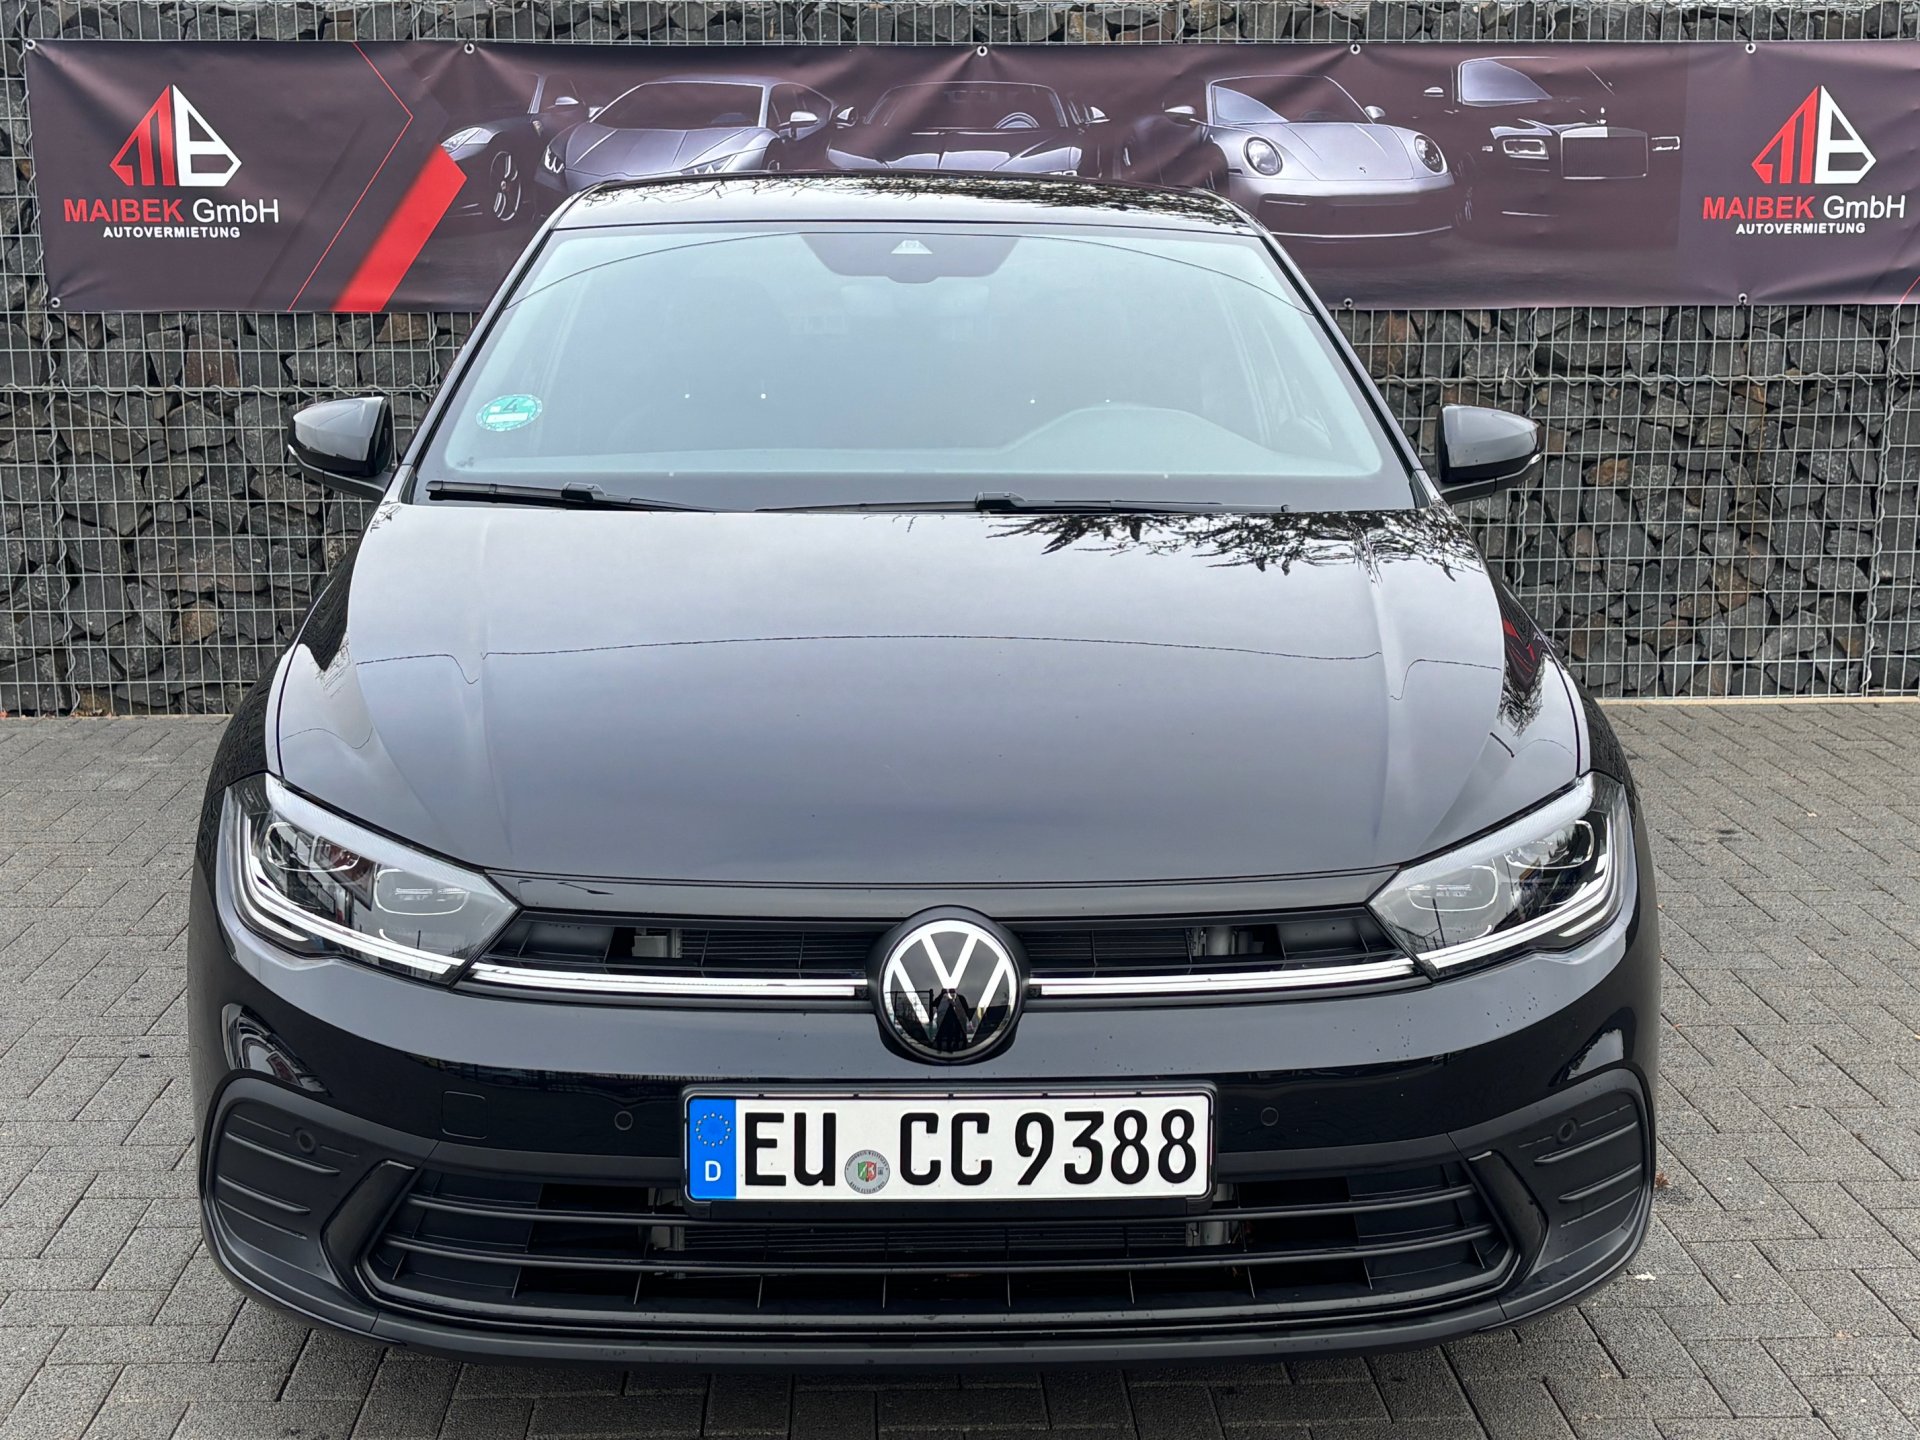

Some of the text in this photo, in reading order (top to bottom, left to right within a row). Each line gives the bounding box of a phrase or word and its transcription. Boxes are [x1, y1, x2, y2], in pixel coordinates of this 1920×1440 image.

[63, 197, 279, 224] MAIBEK GmbH
[1702, 194, 1906, 221] MAIBEK GmbH
[103, 226, 241, 239] AUTOVERMIETUNG
[1735, 222, 1866, 235] AUTOVERMIETUNG
[744, 1109, 1197, 1187] EU CC 9388
[704, 1160, 722, 1182] D
